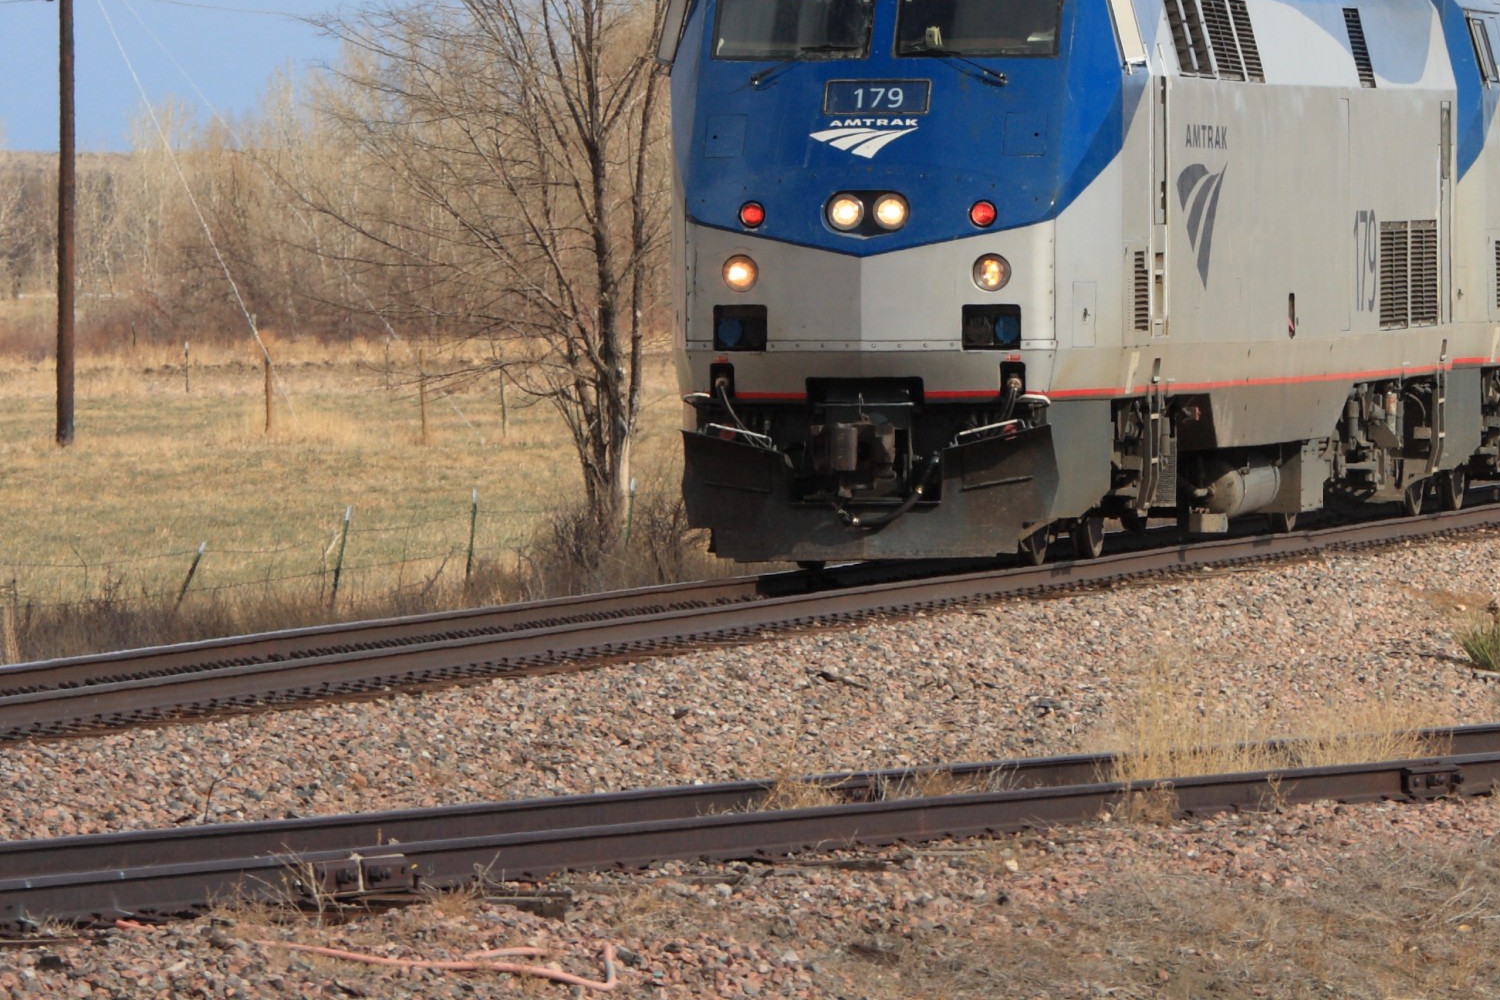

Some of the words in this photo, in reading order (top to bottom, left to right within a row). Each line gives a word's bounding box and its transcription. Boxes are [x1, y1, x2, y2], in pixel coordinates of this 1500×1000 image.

[854, 87, 904, 109] 179
[829, 119, 918, 127] AMTRAK
[1185, 124, 1227, 149] AMTRAK
[1353, 209, 1376, 312] 179
